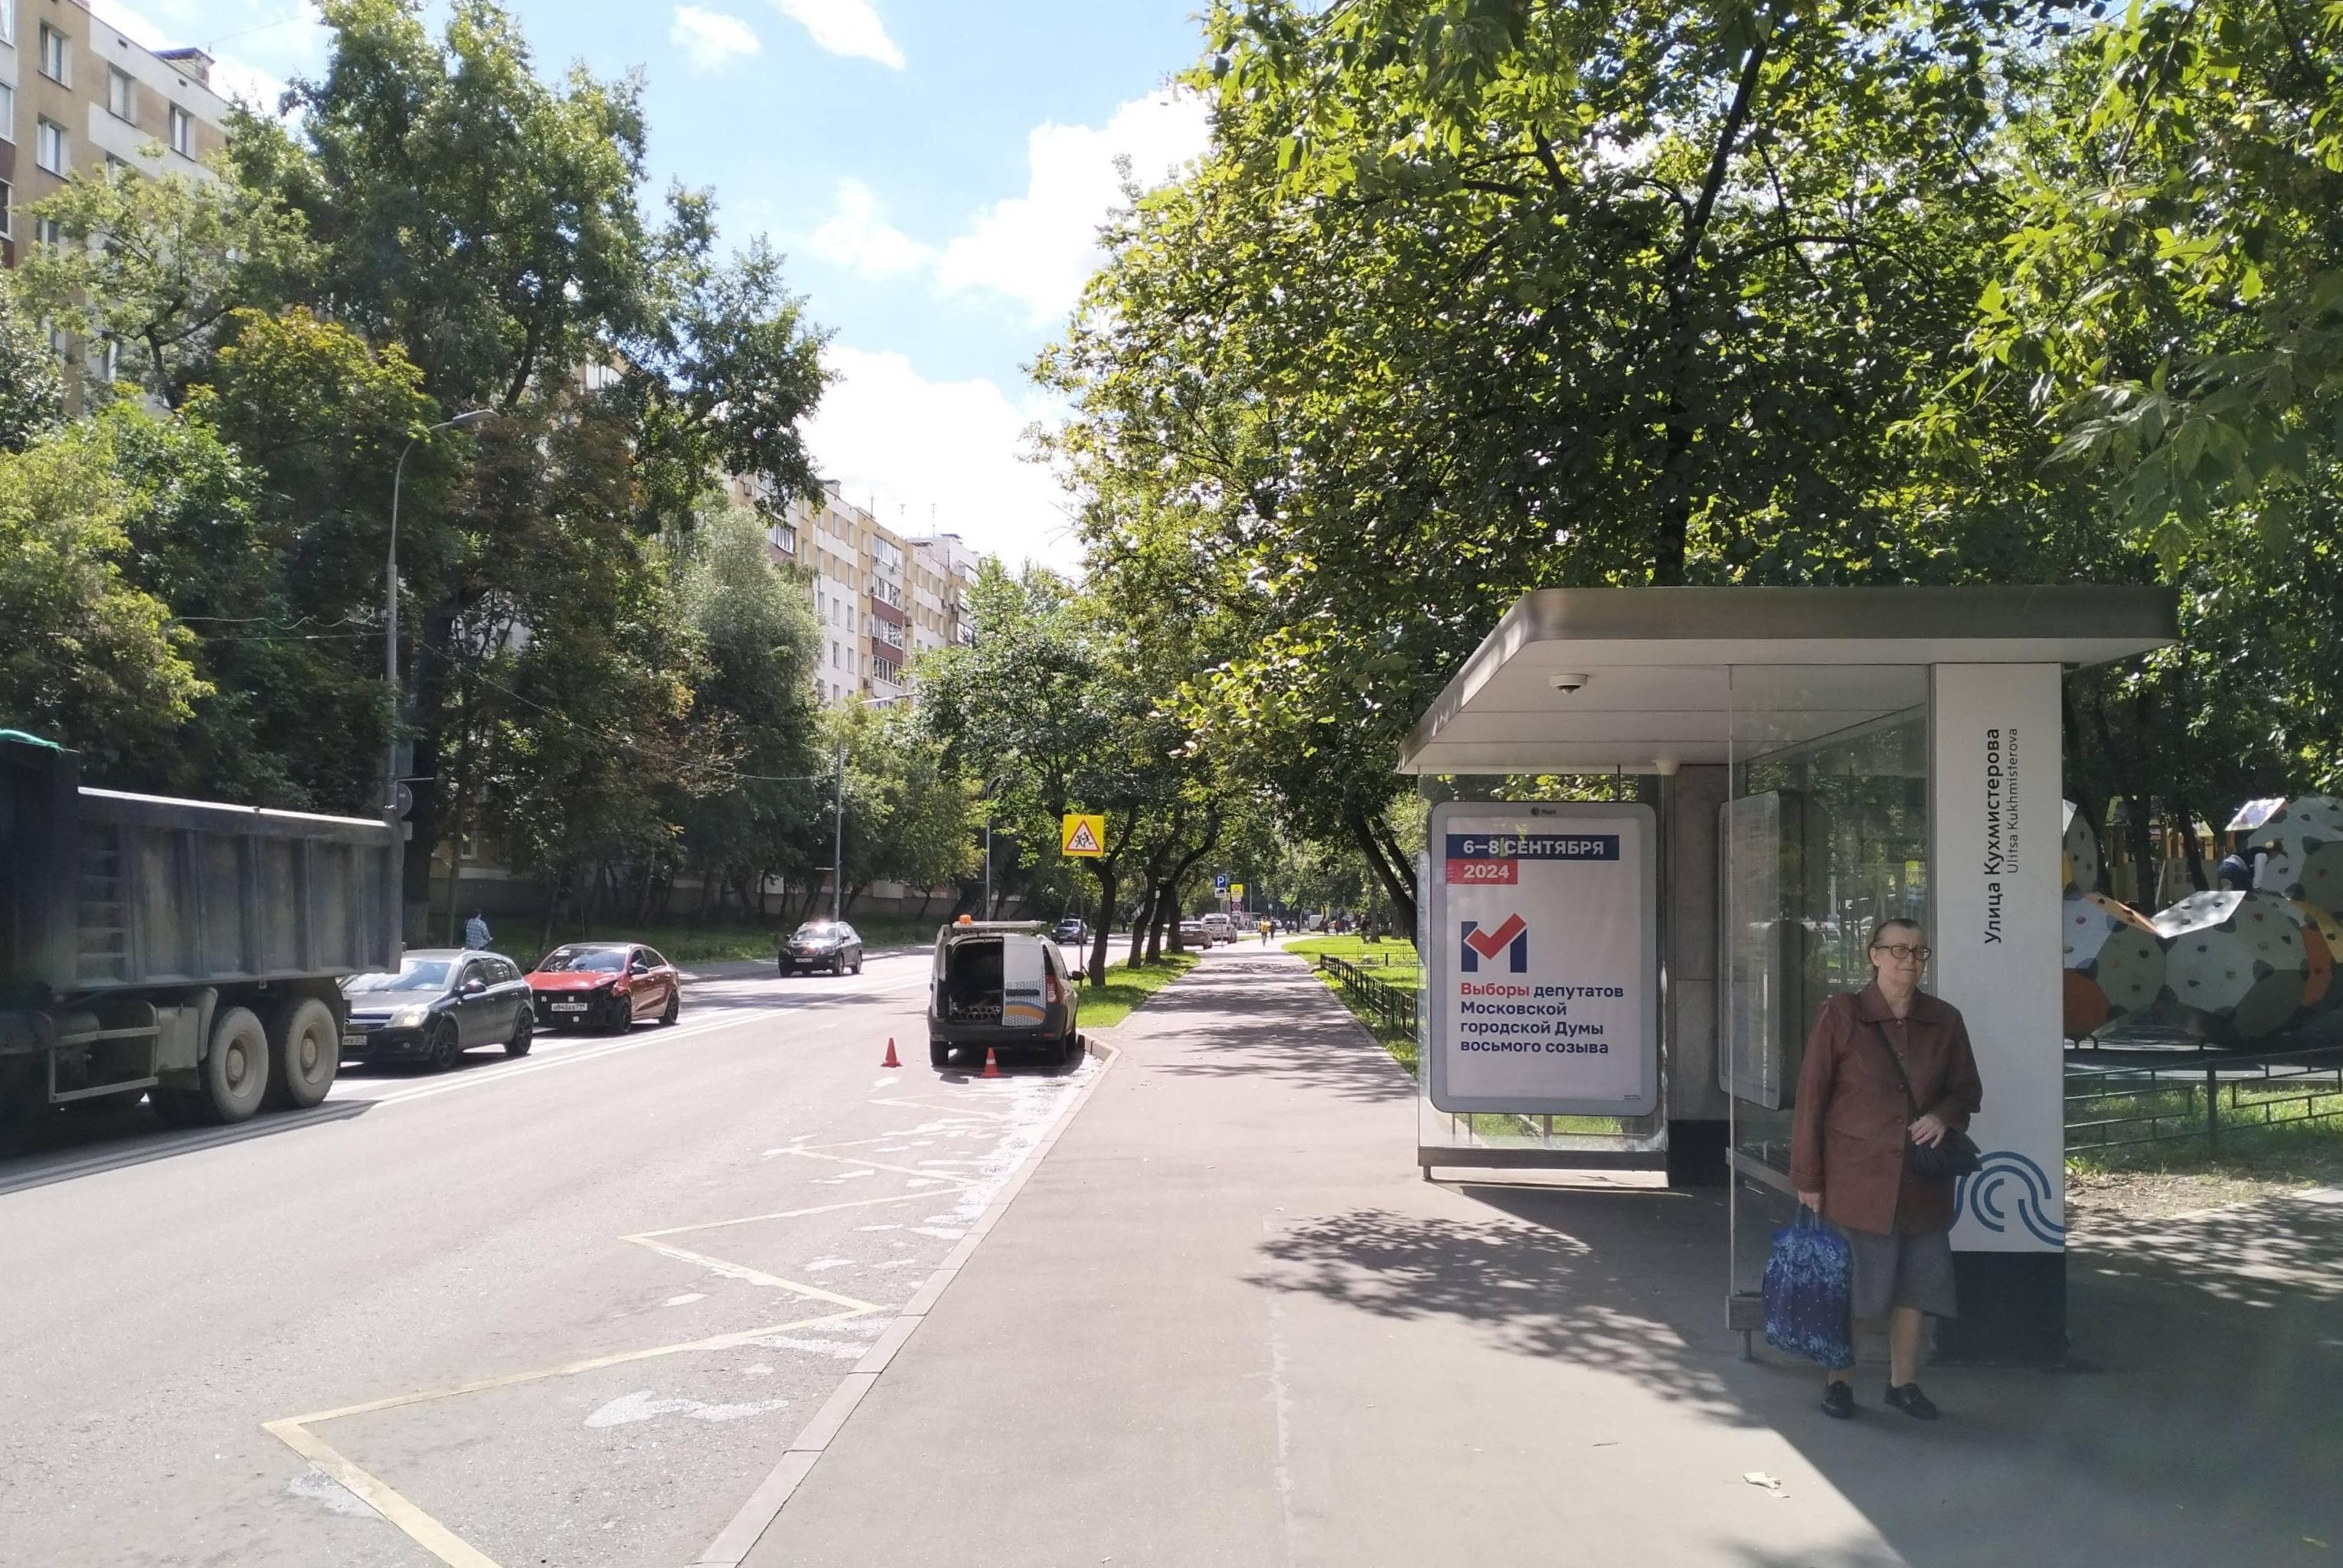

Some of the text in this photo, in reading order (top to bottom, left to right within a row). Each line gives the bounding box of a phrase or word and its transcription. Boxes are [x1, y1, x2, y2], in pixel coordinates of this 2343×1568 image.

[2006, 727, 2018, 874] Ulitsa Kukhmisterova
[1984, 728, 2004, 944] Улица Кухмистерова
[1504, 840, 1605, 855] СЕНТЯБРЯ
[1463, 864, 1510, 879] 2024
[1217, 876, 1225, 887] P
[1460, 982, 1624, 1000] Выборы депутатов
[1460, 1001, 1567, 1016] Московской
[1460, 1021, 1604, 1037] городской Думы
[1460, 1040, 1609, 1054] восьмого созыва
